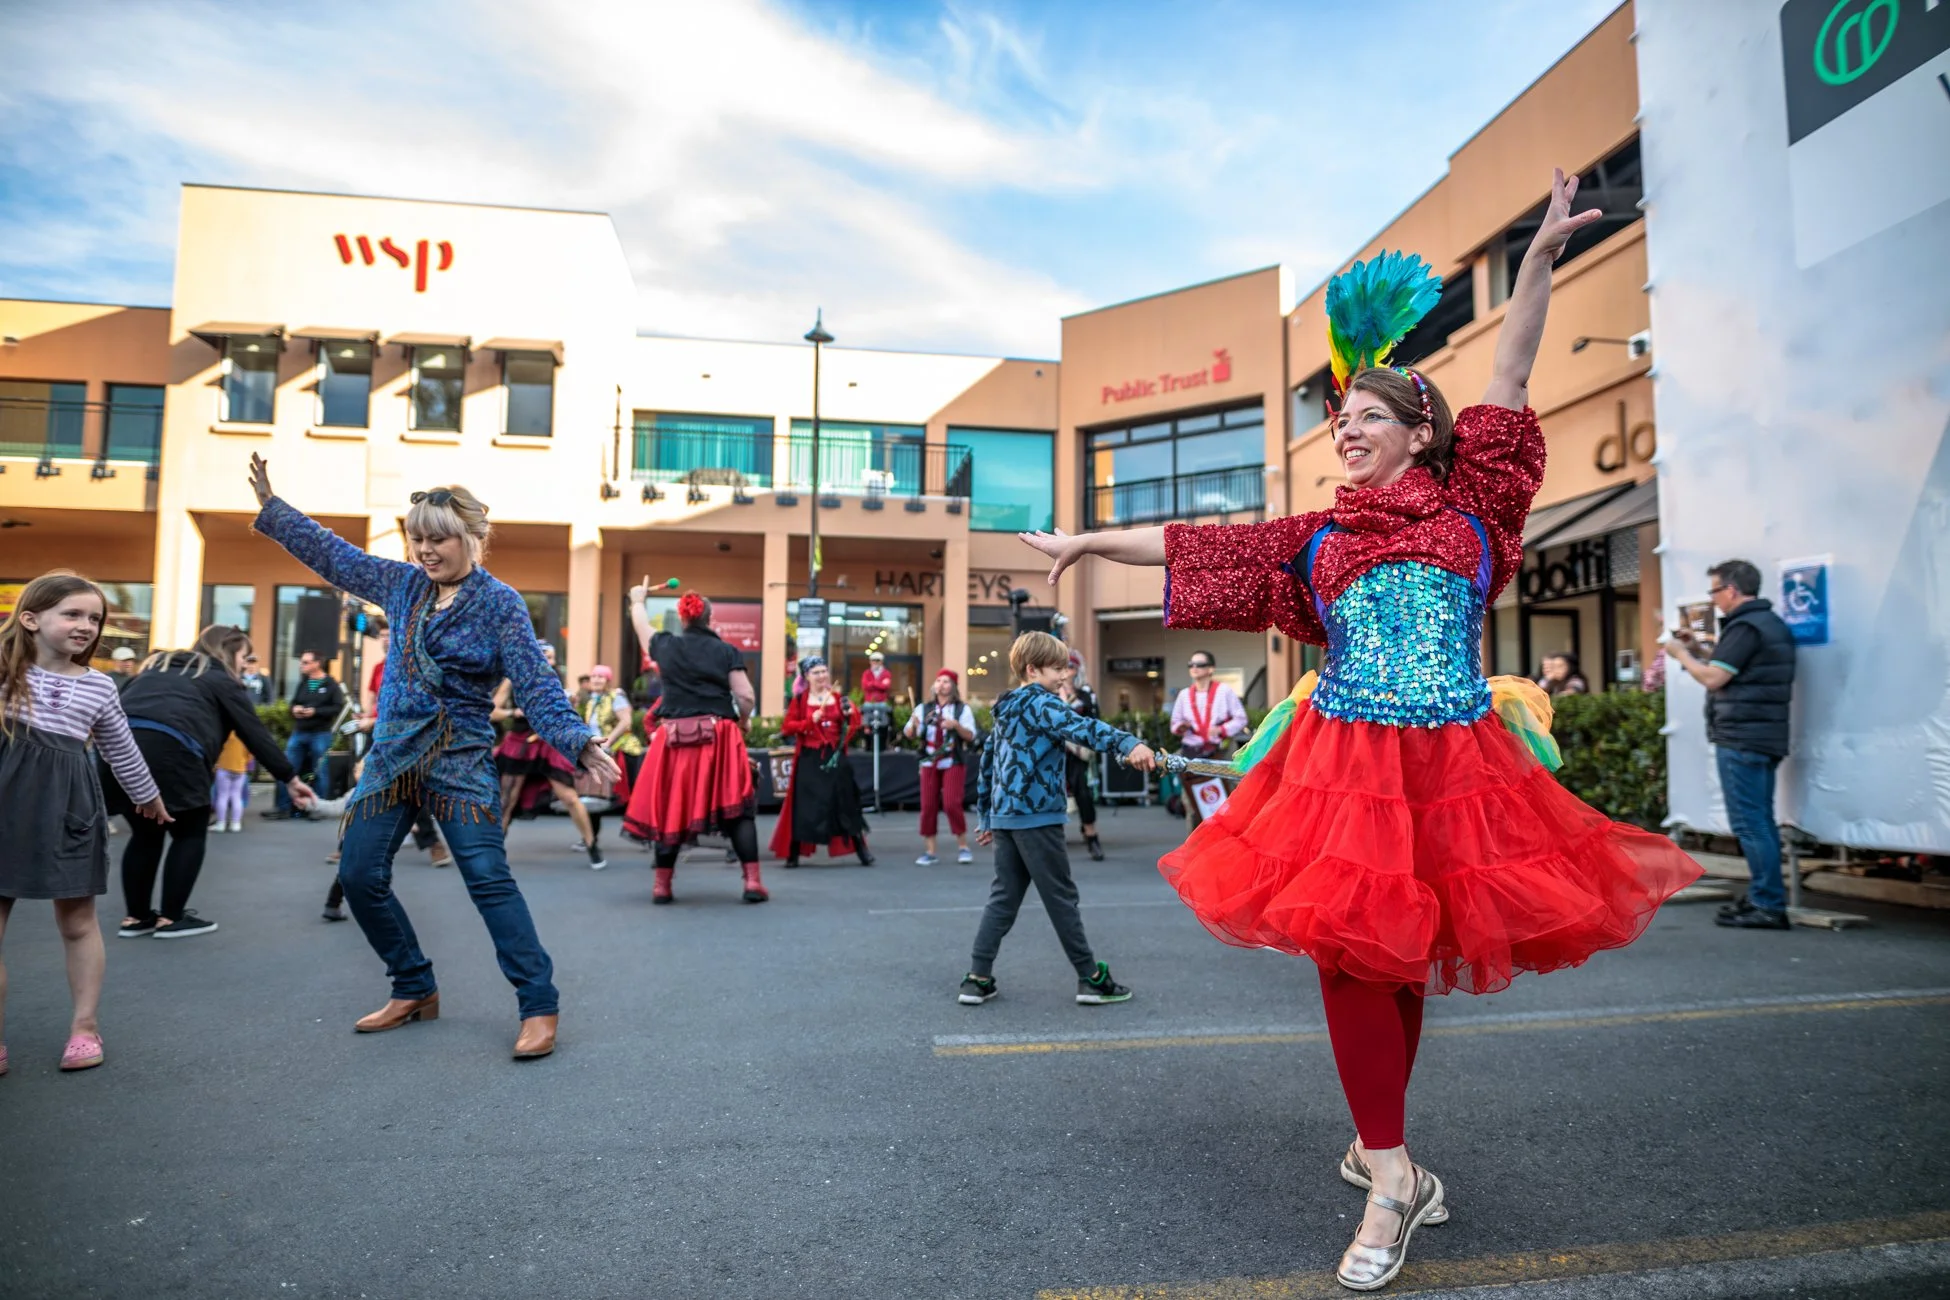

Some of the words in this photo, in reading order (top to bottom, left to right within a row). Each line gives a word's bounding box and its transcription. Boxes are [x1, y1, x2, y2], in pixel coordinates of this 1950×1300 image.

[333, 234, 453, 293] wsp
[1102, 379, 1156, 405] Public
[1159, 369, 1208, 393] Trust
[875, 570, 1012, 600] HARTEYS
